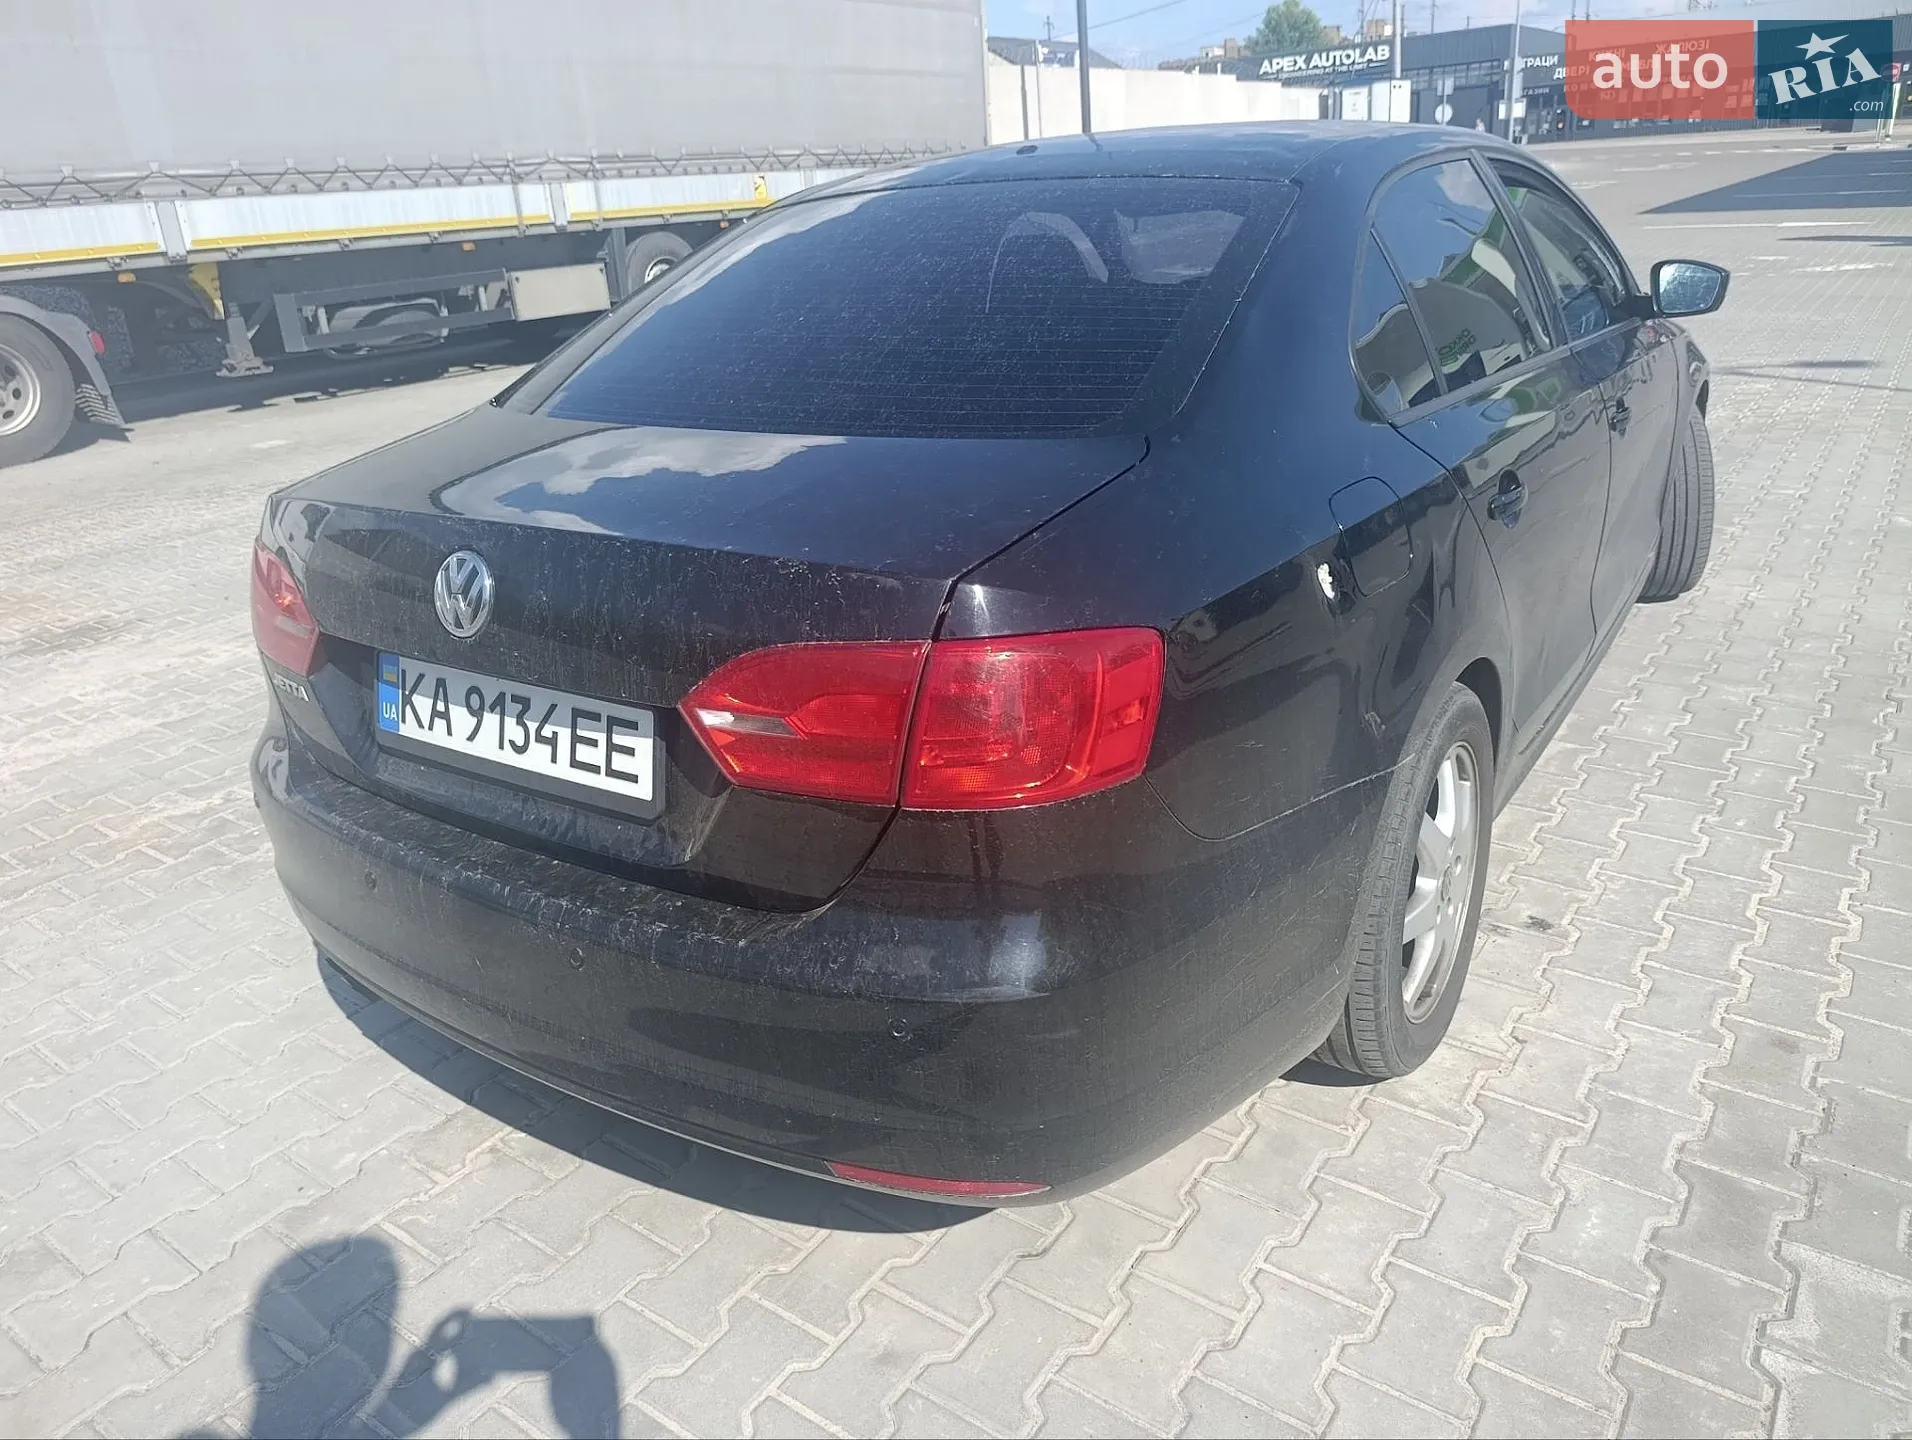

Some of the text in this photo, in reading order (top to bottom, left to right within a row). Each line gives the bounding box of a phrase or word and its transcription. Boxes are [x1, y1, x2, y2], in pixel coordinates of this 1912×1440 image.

[1259, 45, 1390, 75] APEX AUTOLAB
[382, 702, 398, 721] UA
[401, 669, 640, 784] KA 9134 EE
